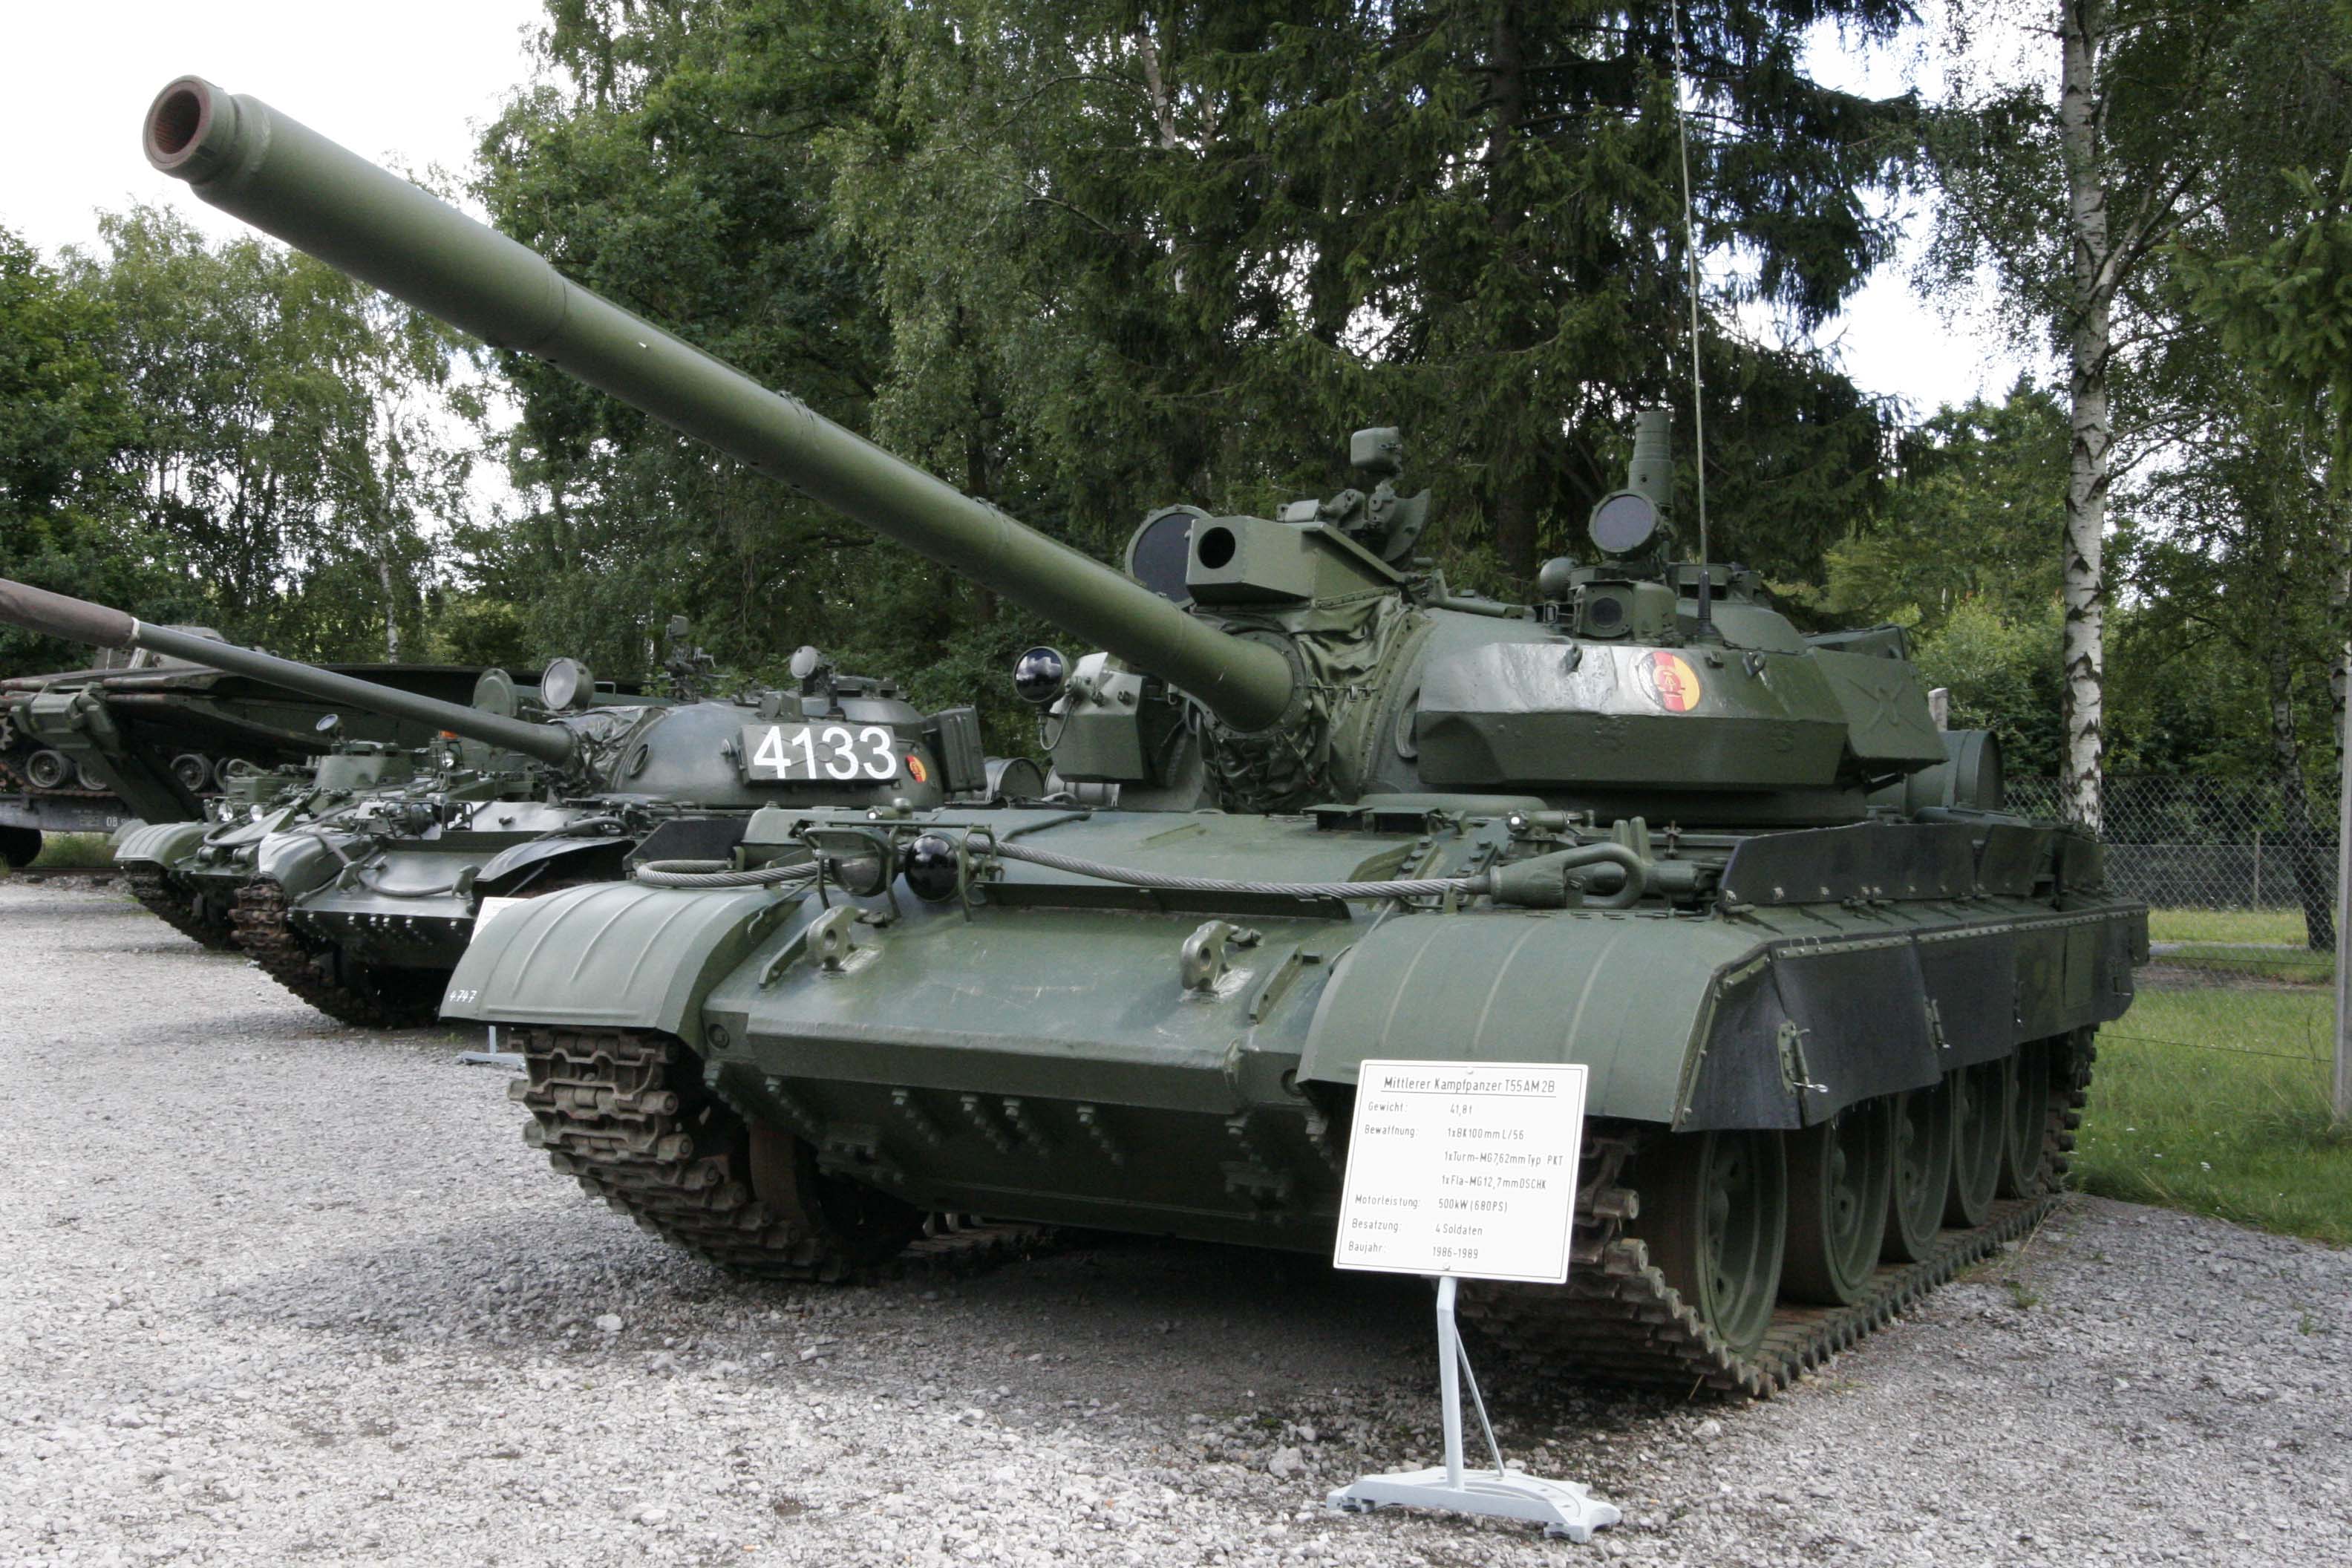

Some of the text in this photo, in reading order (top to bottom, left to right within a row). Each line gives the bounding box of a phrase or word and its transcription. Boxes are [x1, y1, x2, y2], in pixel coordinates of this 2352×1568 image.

[753, 725, 897, 780] 4133
[1383, 1077, 1431, 1090] Mittlerer
[1434, 1077, 1503, 1094] Kampfpanzer
[1368, 1101, 1408, 1113] Gewicht:
[1364, 1124, 1420, 1139] Bewaffnung:
[1547, 1154, 1564, 1166] PKT
[1354, 1194, 1421, 1209] Motorleistung:
[1351, 1218, 1483, 1235] Besatzung: 4 Soldaten
[1432, 1247, 1480, 1259] 1986-1989
